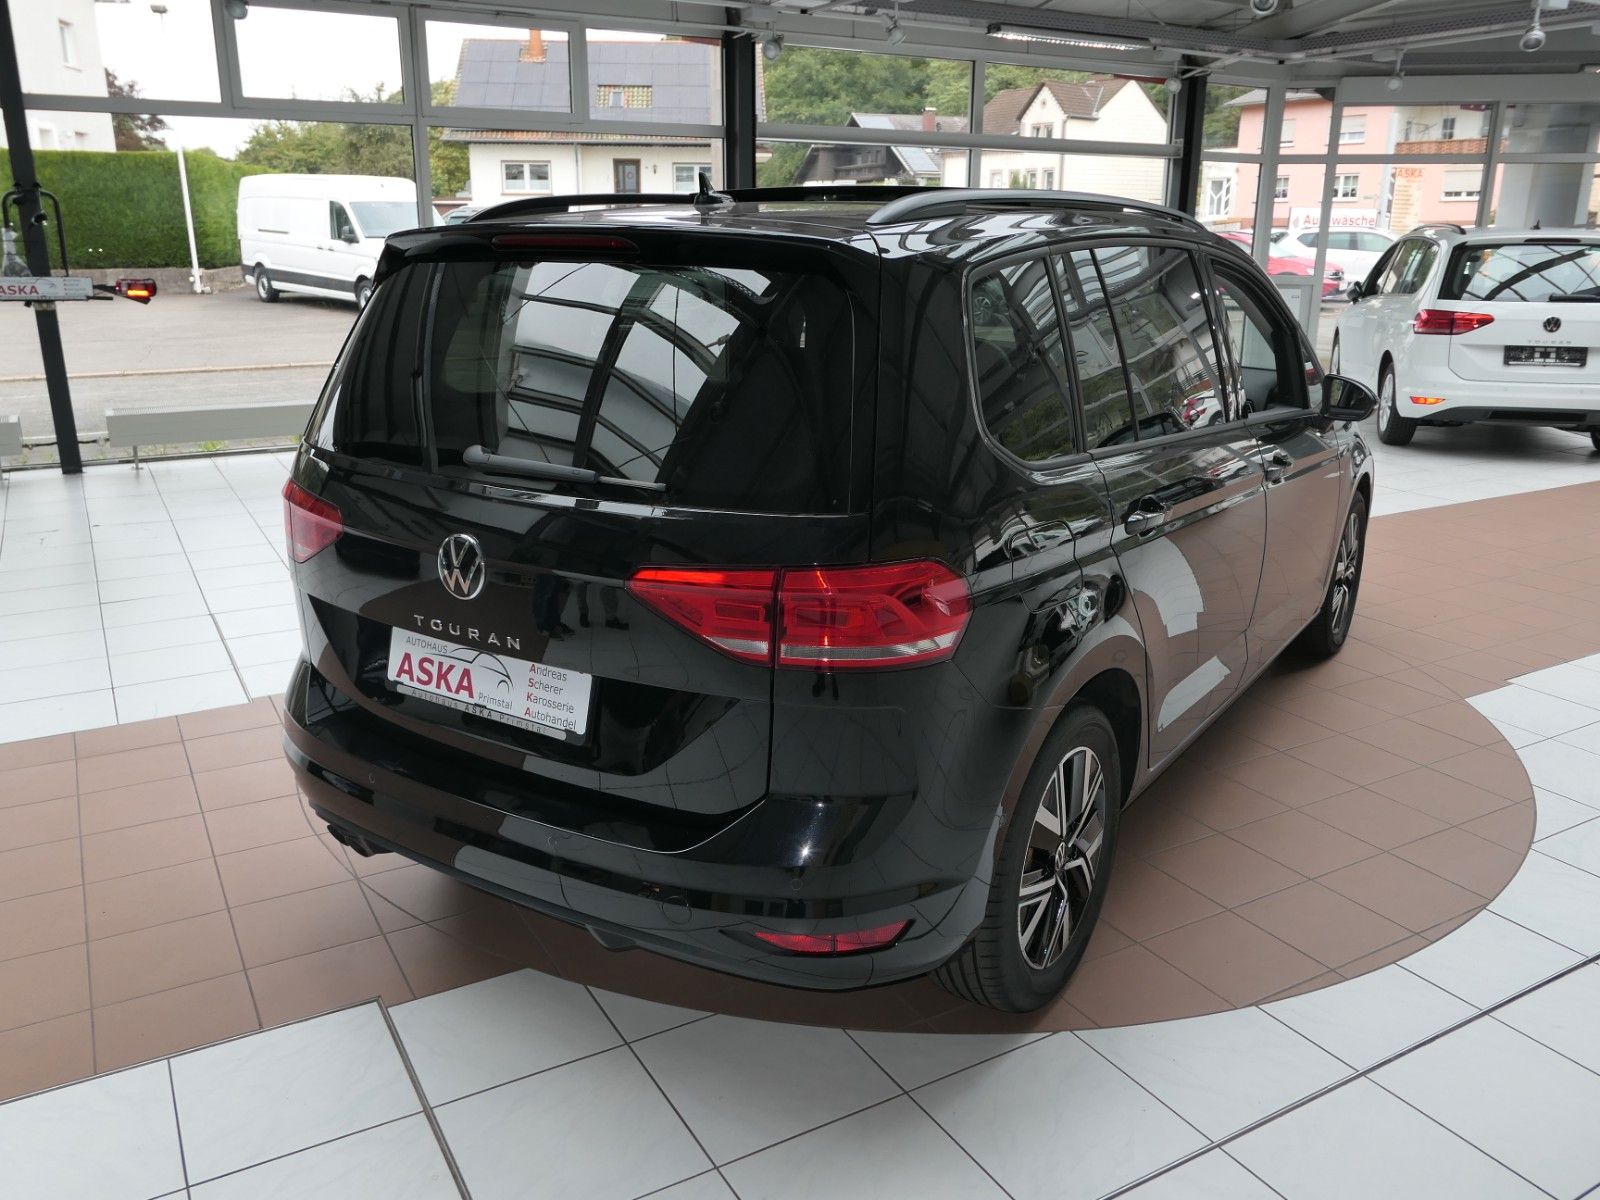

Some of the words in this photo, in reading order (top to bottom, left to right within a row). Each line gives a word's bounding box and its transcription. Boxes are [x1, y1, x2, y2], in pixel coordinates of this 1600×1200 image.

[1303, 214, 1375, 227] Auwäsche
[0, 285, 39, 296] ASKA
[413, 614, 521, 651] TOURAN
[406, 636, 448, 654] AUTOHAUS
[395, 652, 474, 699] ASKA
[529, 664, 568, 682] Andreas
[528, 678, 564, 696] Scherer
[411, 689, 459, 708] Autohaus
[464, 704, 493, 719] ASKA
[479, 692, 513, 711] Primstal
[526, 692, 575, 714] Karosserie
[524, 707, 577, 730] Autohandel
